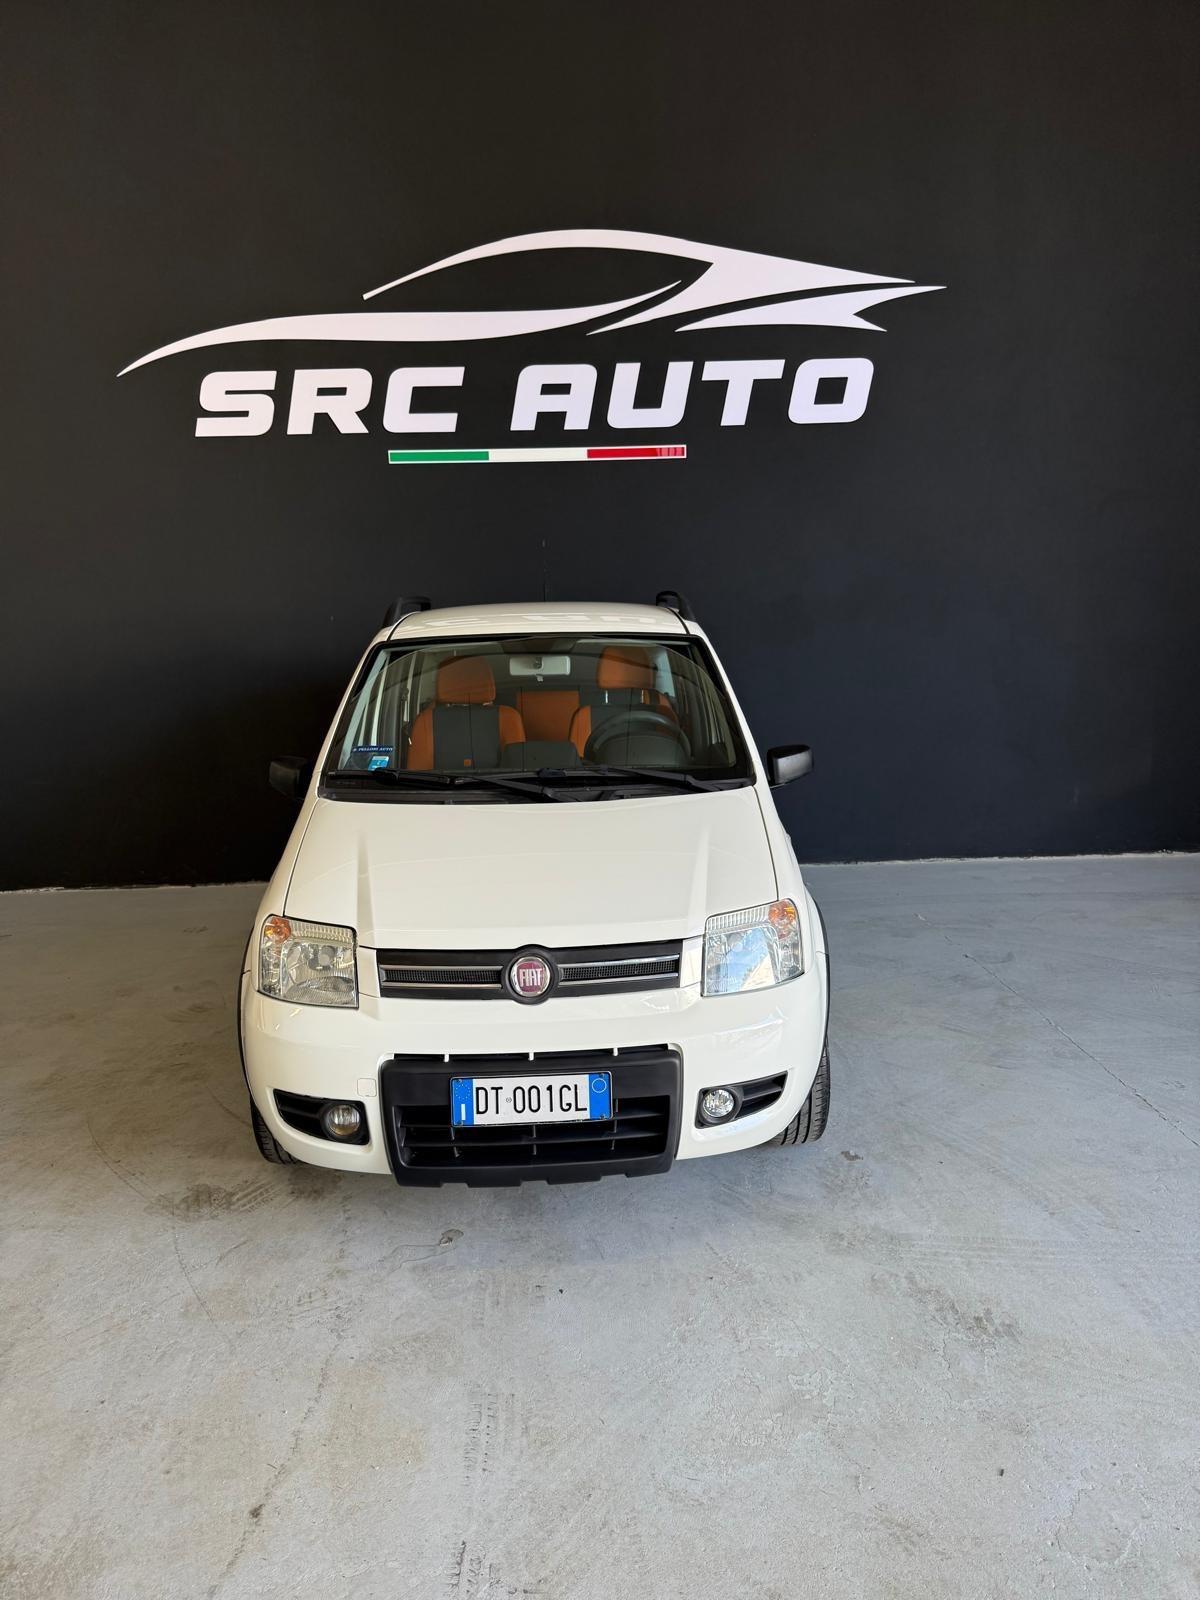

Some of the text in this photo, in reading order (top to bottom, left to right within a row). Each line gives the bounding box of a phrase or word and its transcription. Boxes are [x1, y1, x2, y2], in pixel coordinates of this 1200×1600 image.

[194, 357, 875, 438] SRC AUTO
[519, 968, 543, 988] FIAT
[475, 1084, 588, 1115] DT 001GL
